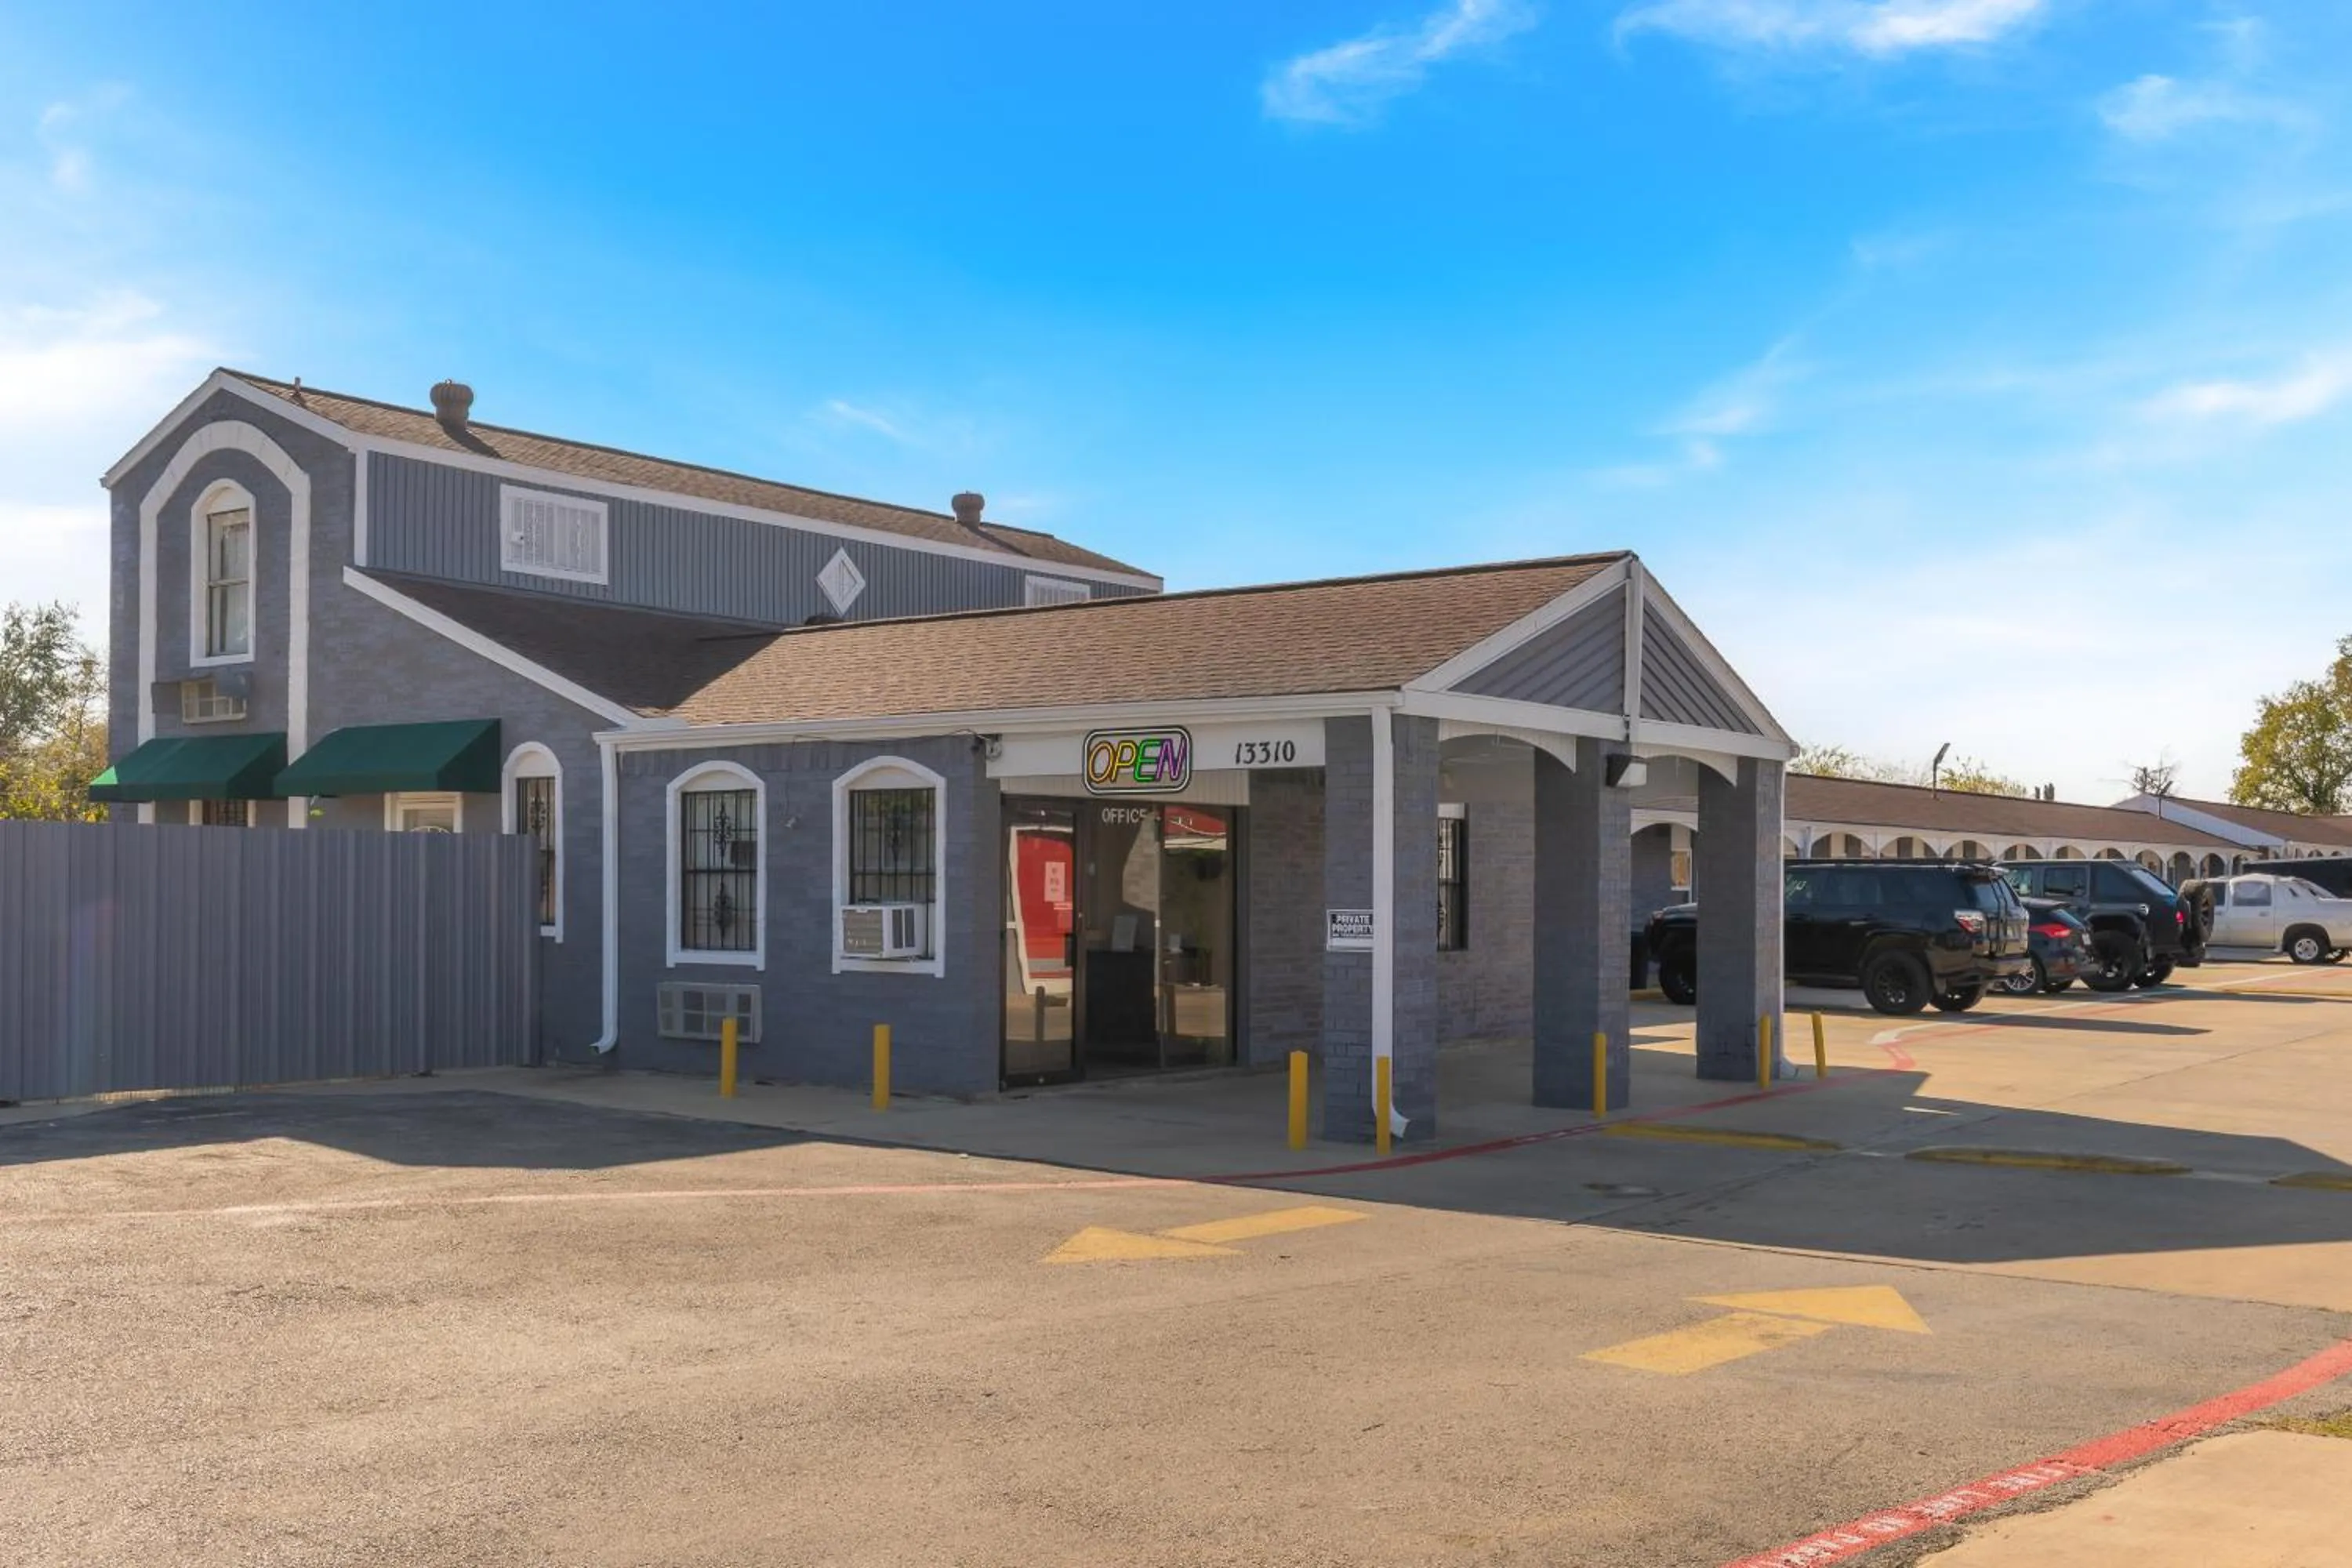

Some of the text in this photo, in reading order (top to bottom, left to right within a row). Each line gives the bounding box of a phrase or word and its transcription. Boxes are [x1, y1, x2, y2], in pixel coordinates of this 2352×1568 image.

[1088, 737, 1187, 782] OPEN
[1236, 740, 1296, 764] 13310
[1336, 915, 1370, 924] PRIVATE
[1332, 924, 1374, 935] PROPERTY
